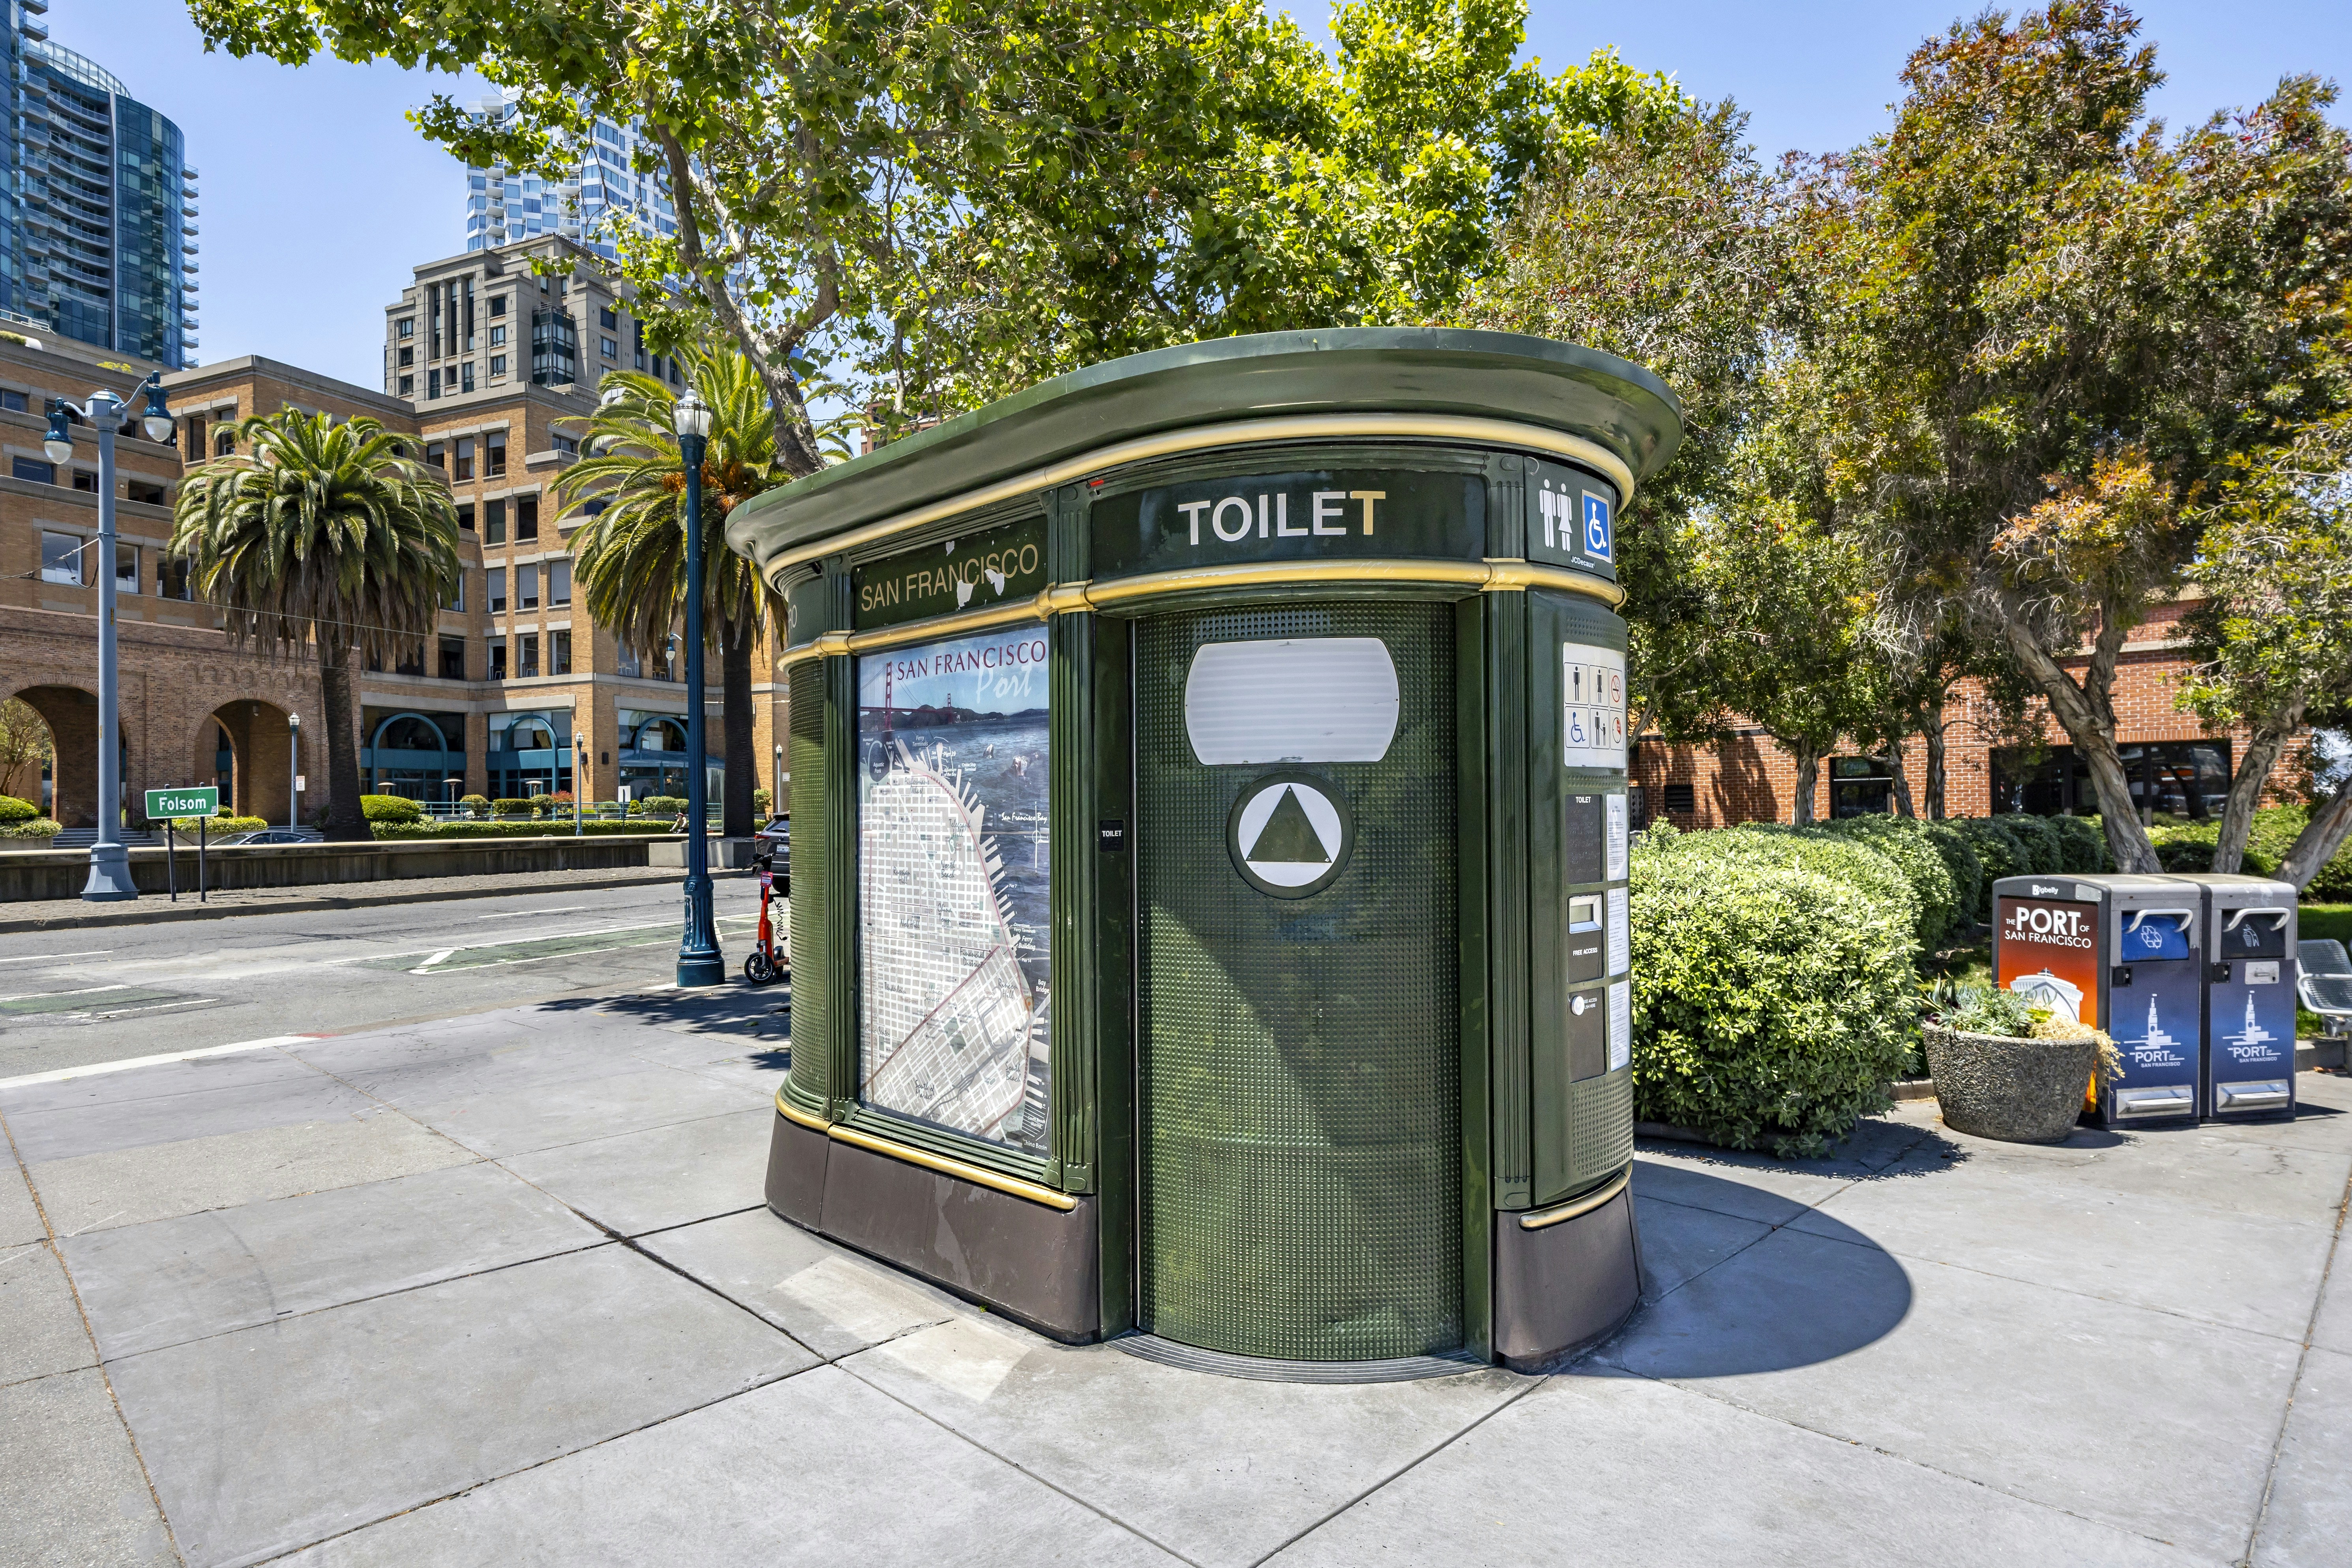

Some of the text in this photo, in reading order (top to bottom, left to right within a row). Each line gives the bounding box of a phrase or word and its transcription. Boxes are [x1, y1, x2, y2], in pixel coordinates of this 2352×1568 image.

[1177, 491, 1386, 545] TOILET
[1571, 556, 1594, 568] JCDecaux
[861, 544, 1038, 612] SAN FRANCISCO
[897, 640, 1046, 680] SAN FRANCISCO
[976, 657, 1033, 704] Port
[159, 796, 206, 811] Folsom
[1001, 812, 1047, 824] San Francisco Bay
[949, 819, 971, 831] Telegraph
[941, 860, 955, 869] North
[893, 867, 911, 876] Russian
[941, 869, 955, 878] Beach
[898, 876, 907, 884] Hill
[2032, 884, 2058, 895] Bigbelly
[937, 903, 952, 912] China
[910, 920, 920, 928] Hill
[939, 913, 951, 923] Town
[2016, 907, 2081, 936] PORT
[2005, 930, 2091, 948] SAN FRANCISCO
[1018, 942, 1036, 951] Building
[960, 947, 984, 959] Financial
[963, 957, 983, 967] District
[885, 982, 906, 994] Tenderloin
[998, 978, 1018, 989] Rincon
[924, 992, 940, 1004] Square
[1003, 989, 1014, 999] Hill
[865, 1024, 890, 1037] Civic Center
[2135, 1051, 2170, 1063] PORT
[2233, 1046, 2267, 1058] PORT
[1005, 1062, 1021, 1072] South
[1006, 1072, 1021, 1083] Beach
[916, 1079, 935, 1096] South of
[916, 1089, 932, 1101] Market
